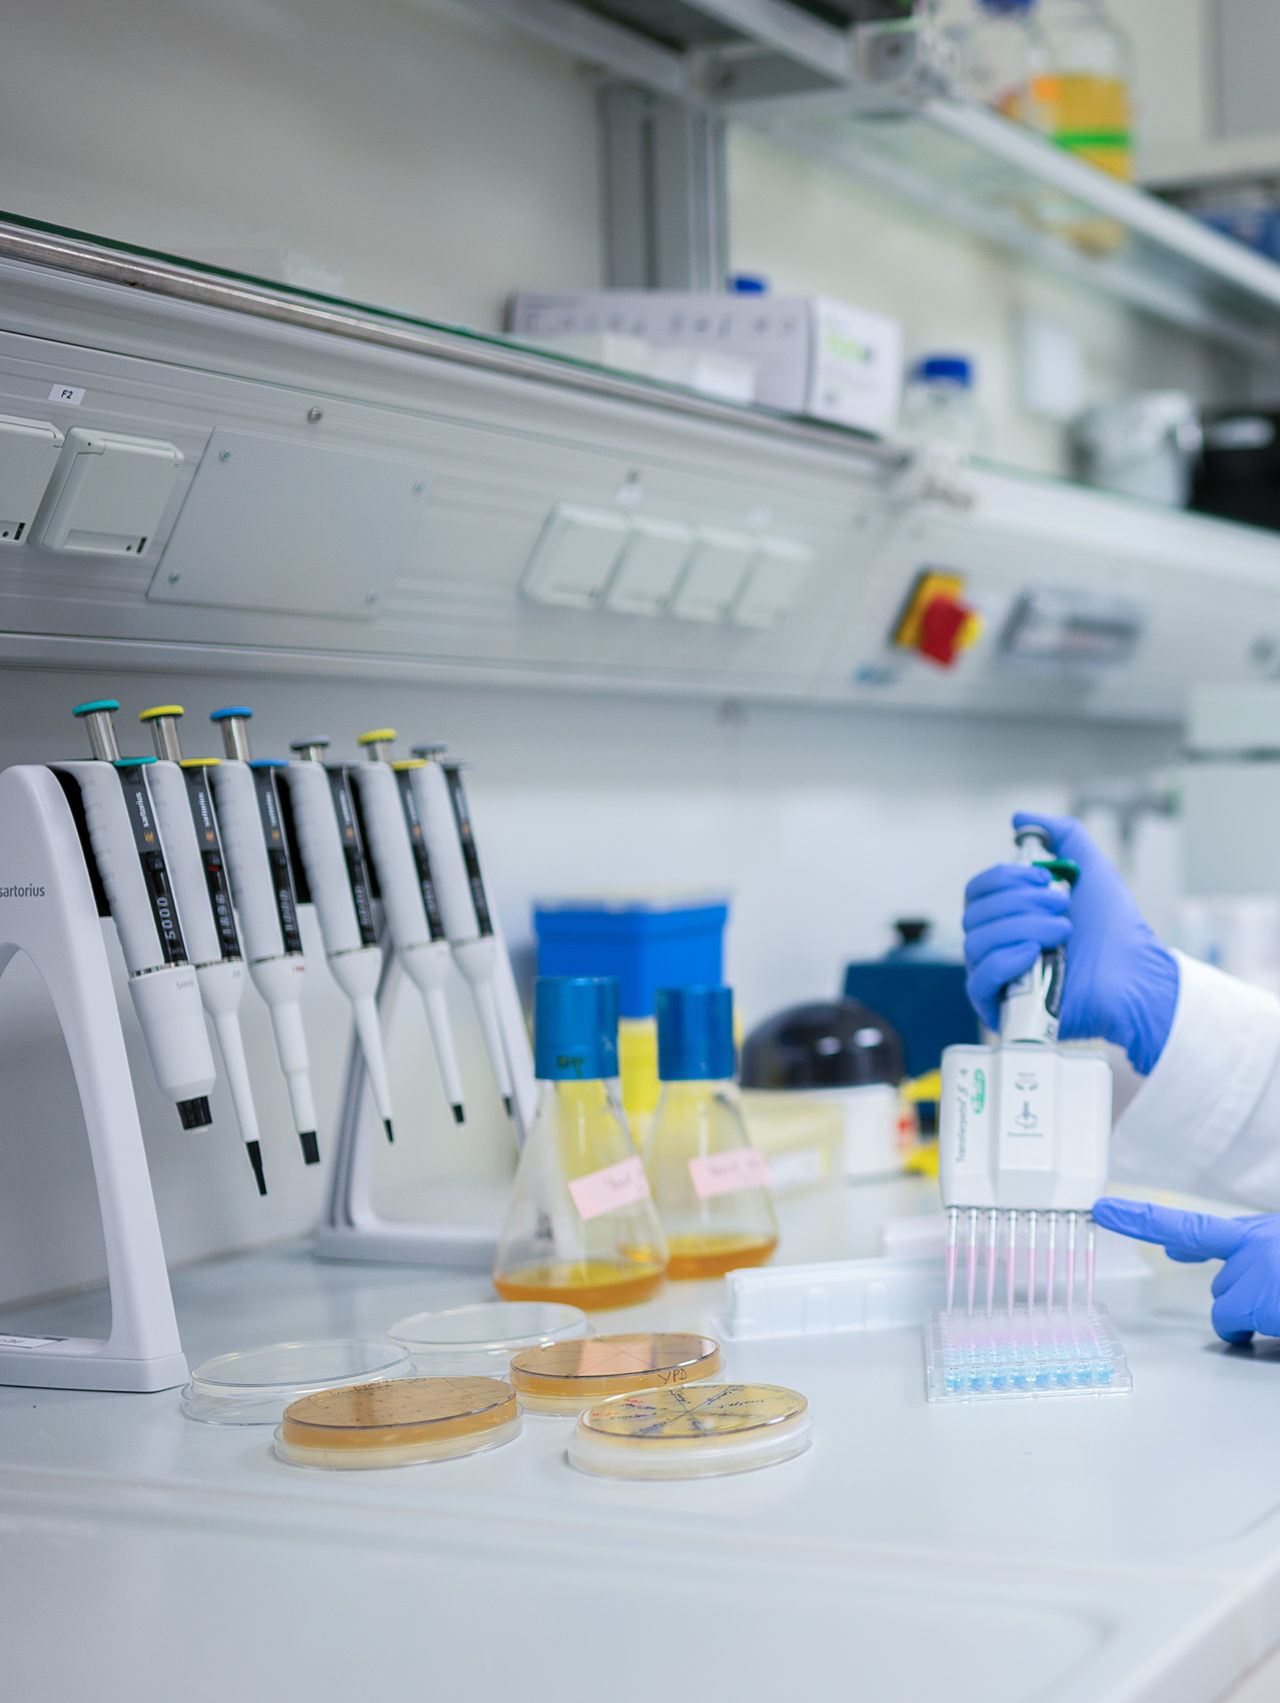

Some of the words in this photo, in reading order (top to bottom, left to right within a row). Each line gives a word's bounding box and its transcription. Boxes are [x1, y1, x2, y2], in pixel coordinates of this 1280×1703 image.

[61, 389, 73, 400] F2
[0, 883, 45, 897] sartorius
[157, 896, 177, 940] 5000
[657, 1368, 687, 1384] YPD
